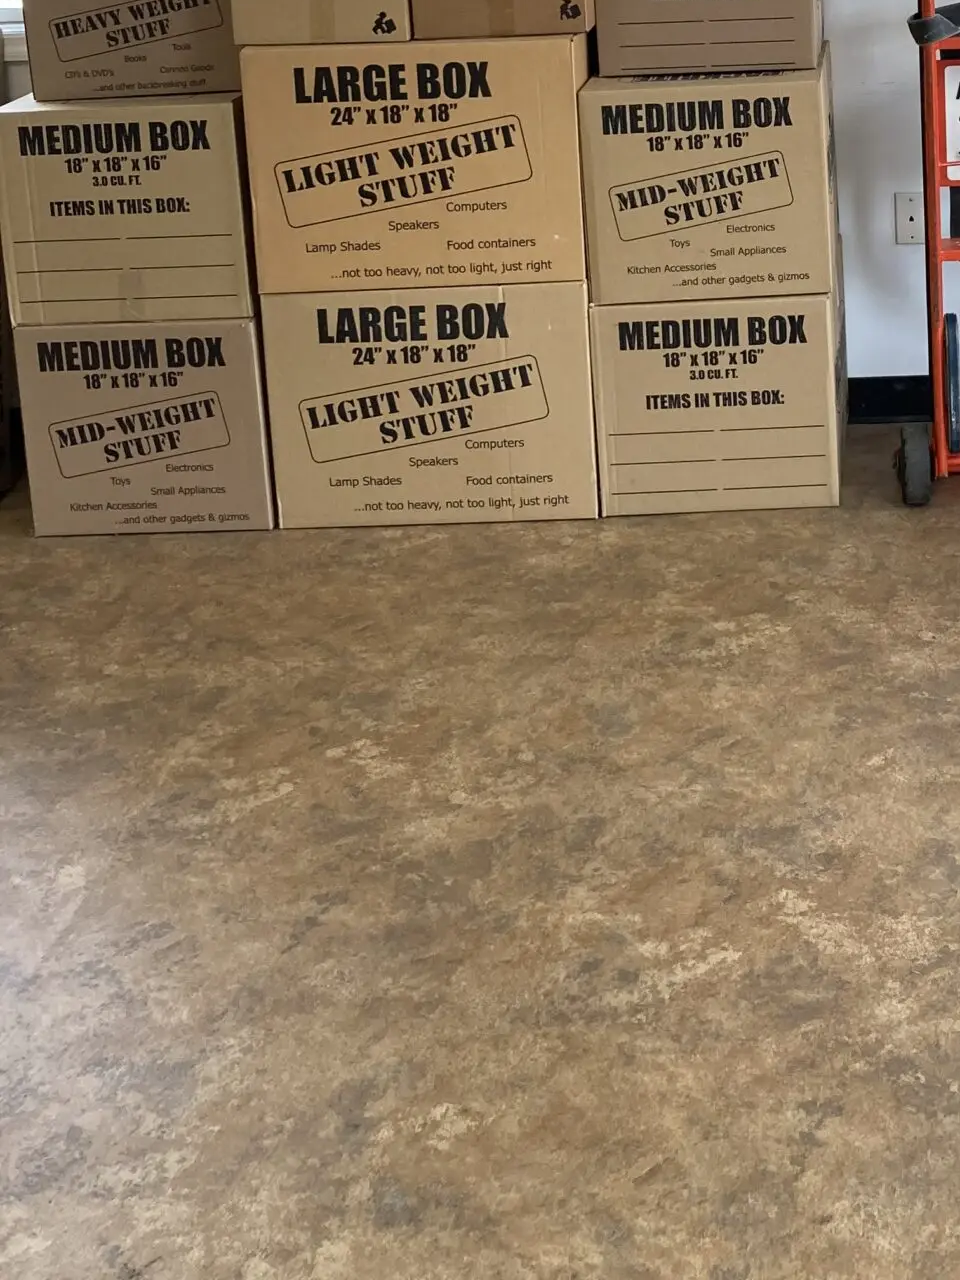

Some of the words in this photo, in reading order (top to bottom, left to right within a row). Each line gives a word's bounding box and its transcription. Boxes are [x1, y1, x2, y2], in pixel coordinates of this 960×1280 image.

[53, 8, 123, 39] HEAVY
[105, 18, 171, 48] STUFF
[293, 63, 408, 104] LARGE
[416, 61, 492, 100] BOX
[601, 99, 725, 135] MEDIUM
[731, 96, 793, 129] BOX
[17, 121, 142, 156] MEDIUM
[148, 119, 211, 151] BOX
[281, 151, 381, 194] LIGHT
[388, 123, 517, 172] WEIGHT
[92, 175, 108, 187] 3.0
[110, 175, 127, 186] CU.
[128, 174, 142, 186] FT.
[358, 166, 456, 208] STUFF
[615, 157, 780, 211] MID-WEIGHT
[49, 199, 96, 217] ITEMS
[98, 199, 114, 215] IN
[117, 197, 153, 215] THIS
[155, 196, 191, 213] BOX:
[446, 200, 508, 214] Computers
[663, 190, 744, 226] STUFF
[388, 219, 440, 233] Speakers
[726, 223, 776, 233] Electronics
[305, 241, 337, 255] Lamp
[339, 239, 381, 252] Shades
[446, 238, 475, 250] Food
[479, 236, 537, 249] containers
[669, 238, 691, 249] Toys
[710, 247, 735, 257] Small
[738, 245, 787, 257] Appliances
[364, 268, 383, 278] too
[385, 266, 422, 279] heavy,
[425, 264, 445, 275] not
[447, 264, 467, 274] too
[469, 261, 498, 275] light,
[500, 261, 523, 273] just
[525, 258, 553, 273] right
[626, 264, 661, 275] Kitchen
[663, 262, 717, 273] Accessories
[701, 275, 726, 285] other
[728, 274, 765, 285] gadgets
[777, 271, 810, 284] gizmos
[316, 305, 427, 344] LARGE
[436, 302, 509, 341] BOX
[618, 317, 740, 351] MEDIUM
[746, 314, 808, 345] BOX
[36, 338, 159, 372] MEDIUM
[164, 336, 226, 368] BOX
[689, 369, 705, 380] 3.0
[707, 368, 724, 379] CU.
[725, 368, 739, 379] FT.
[306, 390, 400, 429] LIGHT
[408, 363, 533, 409] WEIGHT
[645, 393, 691, 410] ITEMS
[694, 392, 710, 409] IN
[712, 390, 748, 407] THIS
[751, 389, 785, 406] BOX:
[55, 397, 217, 449] MID-WEIGHT
[379, 405, 474, 445] STUFF
[103, 429, 182, 463] STUFF
[464, 438, 525, 451] Computers
[165, 462, 214, 472] Electronics
[408, 456, 459, 468] Speakers
[110, 476, 131, 487] Toys
[329, 476, 360, 489] Lamp
[362, 475, 403, 487] Shades
[465, 474, 493, 486] Food
[496, 473, 553, 484] containers
[150, 486, 176, 496] Small
[177, 485, 226, 496] Appliances
[69, 501, 104, 512] Kitchen
[106, 500, 158, 511] Accessories
[386, 500, 404, 510] too
[407, 498, 442, 512] heavy,
[445, 497, 464, 509] not
[467, 497, 486, 508] too
[488, 495, 516, 509] light,
[519, 494, 540, 508] just
[543, 493, 570, 507] right
[143, 514, 167, 524] other
[169, 513, 206, 524] gadgets
[218, 512, 250, 523] gizmos
